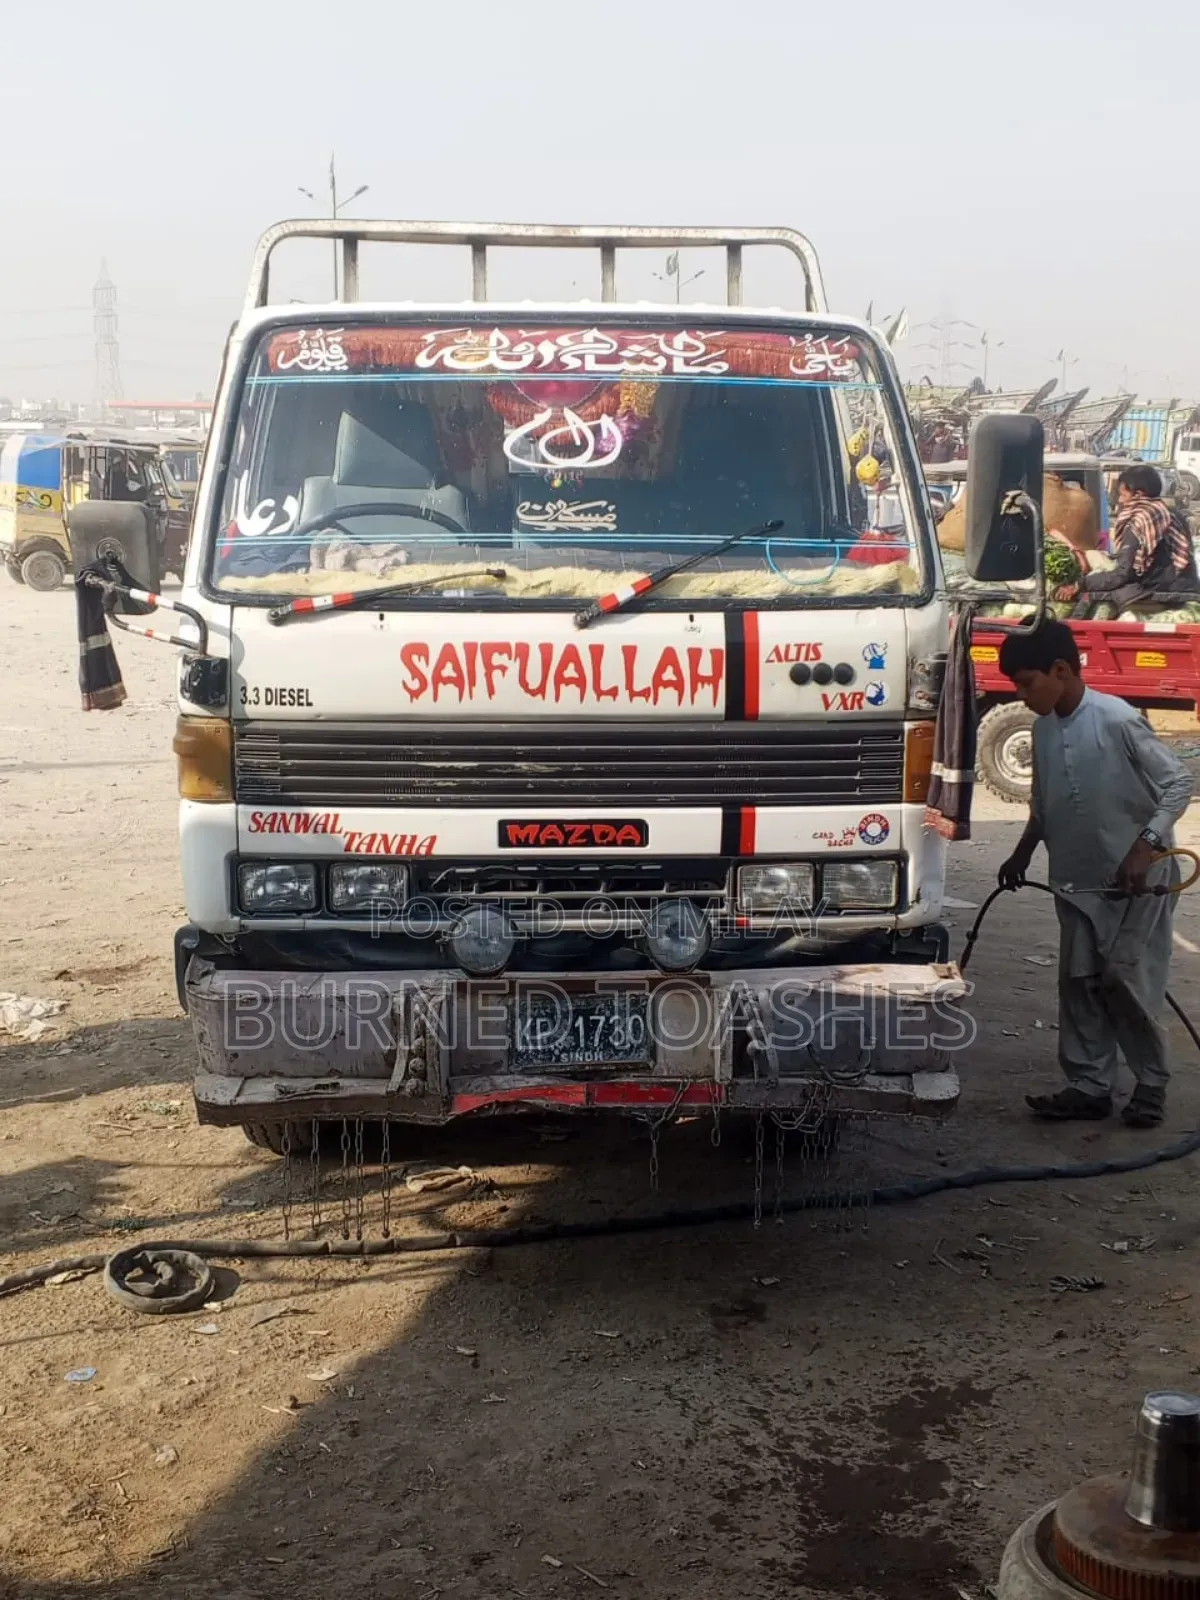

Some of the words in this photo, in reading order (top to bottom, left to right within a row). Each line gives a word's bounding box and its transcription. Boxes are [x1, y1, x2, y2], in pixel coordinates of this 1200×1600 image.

[765, 642, 823, 663] ALTIS
[400, 642, 724, 708] SAIFUALLAH
[240, 686, 260, 706] 3.3
[265, 687, 313, 707] DIESEL
[821, 691, 865, 711] VXR
[248, 811, 344, 835] SANWAL
[506, 823, 641, 846] MAZDA
[342, 831, 438, 857] TANHA
